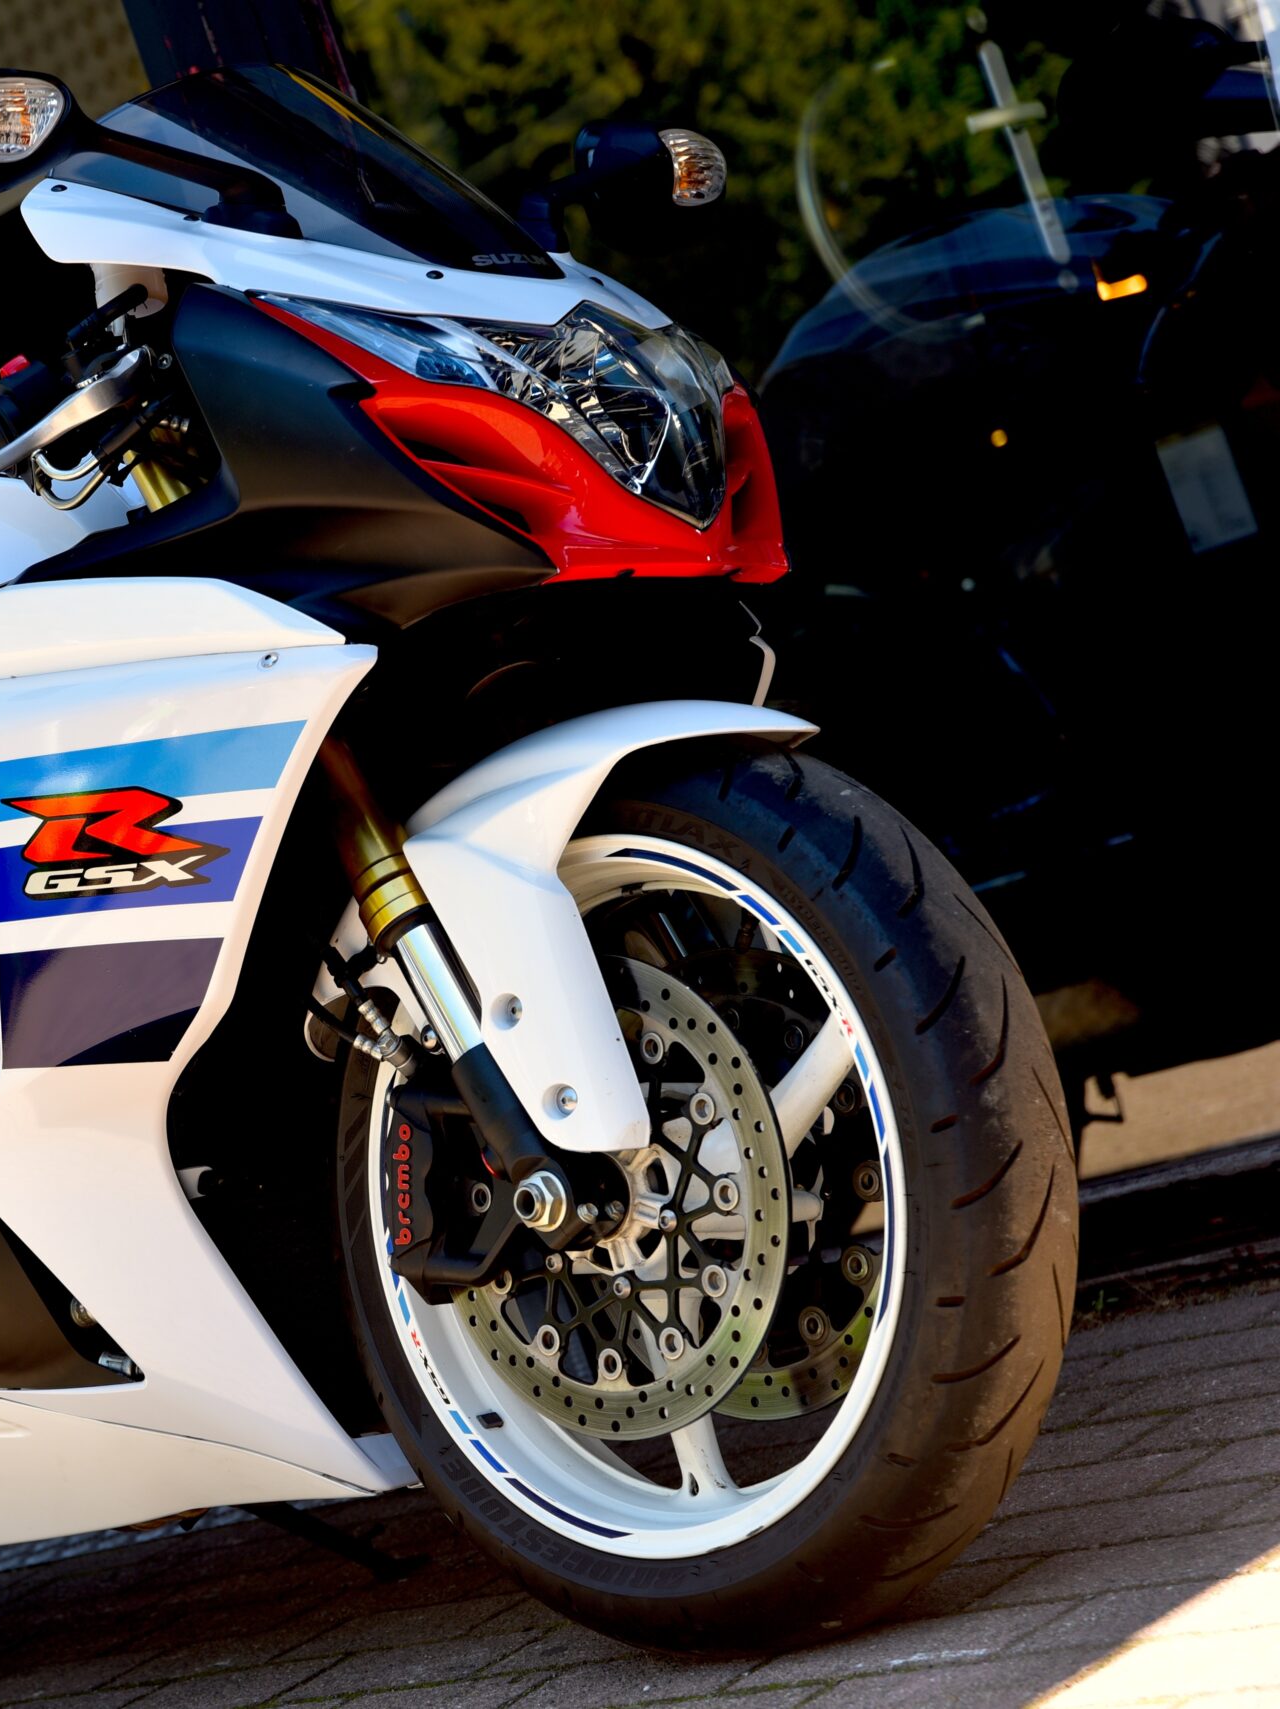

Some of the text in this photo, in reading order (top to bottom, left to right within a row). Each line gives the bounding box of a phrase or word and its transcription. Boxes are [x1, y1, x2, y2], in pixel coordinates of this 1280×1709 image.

[4, 787, 210, 864] R
[23, 853, 208, 896] GSX
[392, 1122, 412, 1246] brembo
[439, 1457, 692, 1590] BRIDGESTONE
